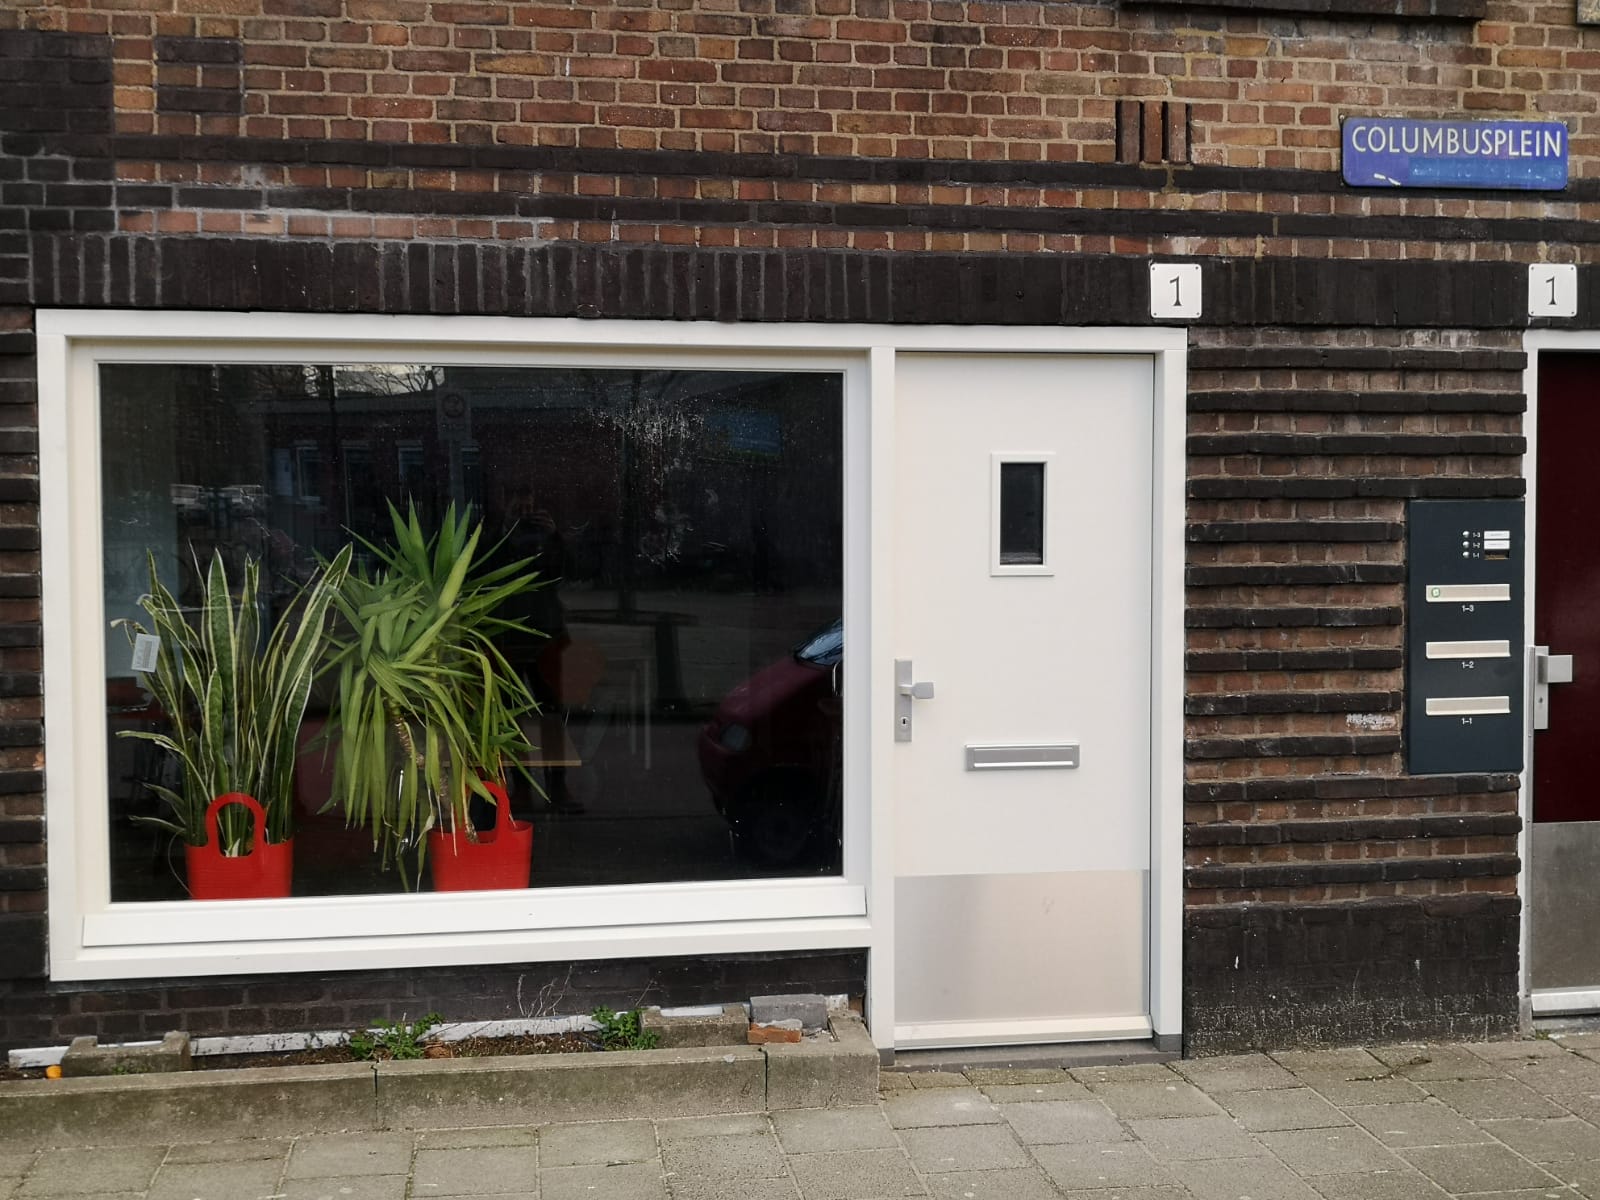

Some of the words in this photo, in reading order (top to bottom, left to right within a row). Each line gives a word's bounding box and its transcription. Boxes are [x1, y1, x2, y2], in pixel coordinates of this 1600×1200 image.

[1351, 126, 1561, 157] COLUMBUSPLEIN
[1169, 275, 1182, 307] 1
[1545, 276, 1558, 306] 1
[1461, 604, 1474, 612] 1-3
[1461, 661, 1474, 669] 1-2
[1461, 717, 1473, 725] 1-1
